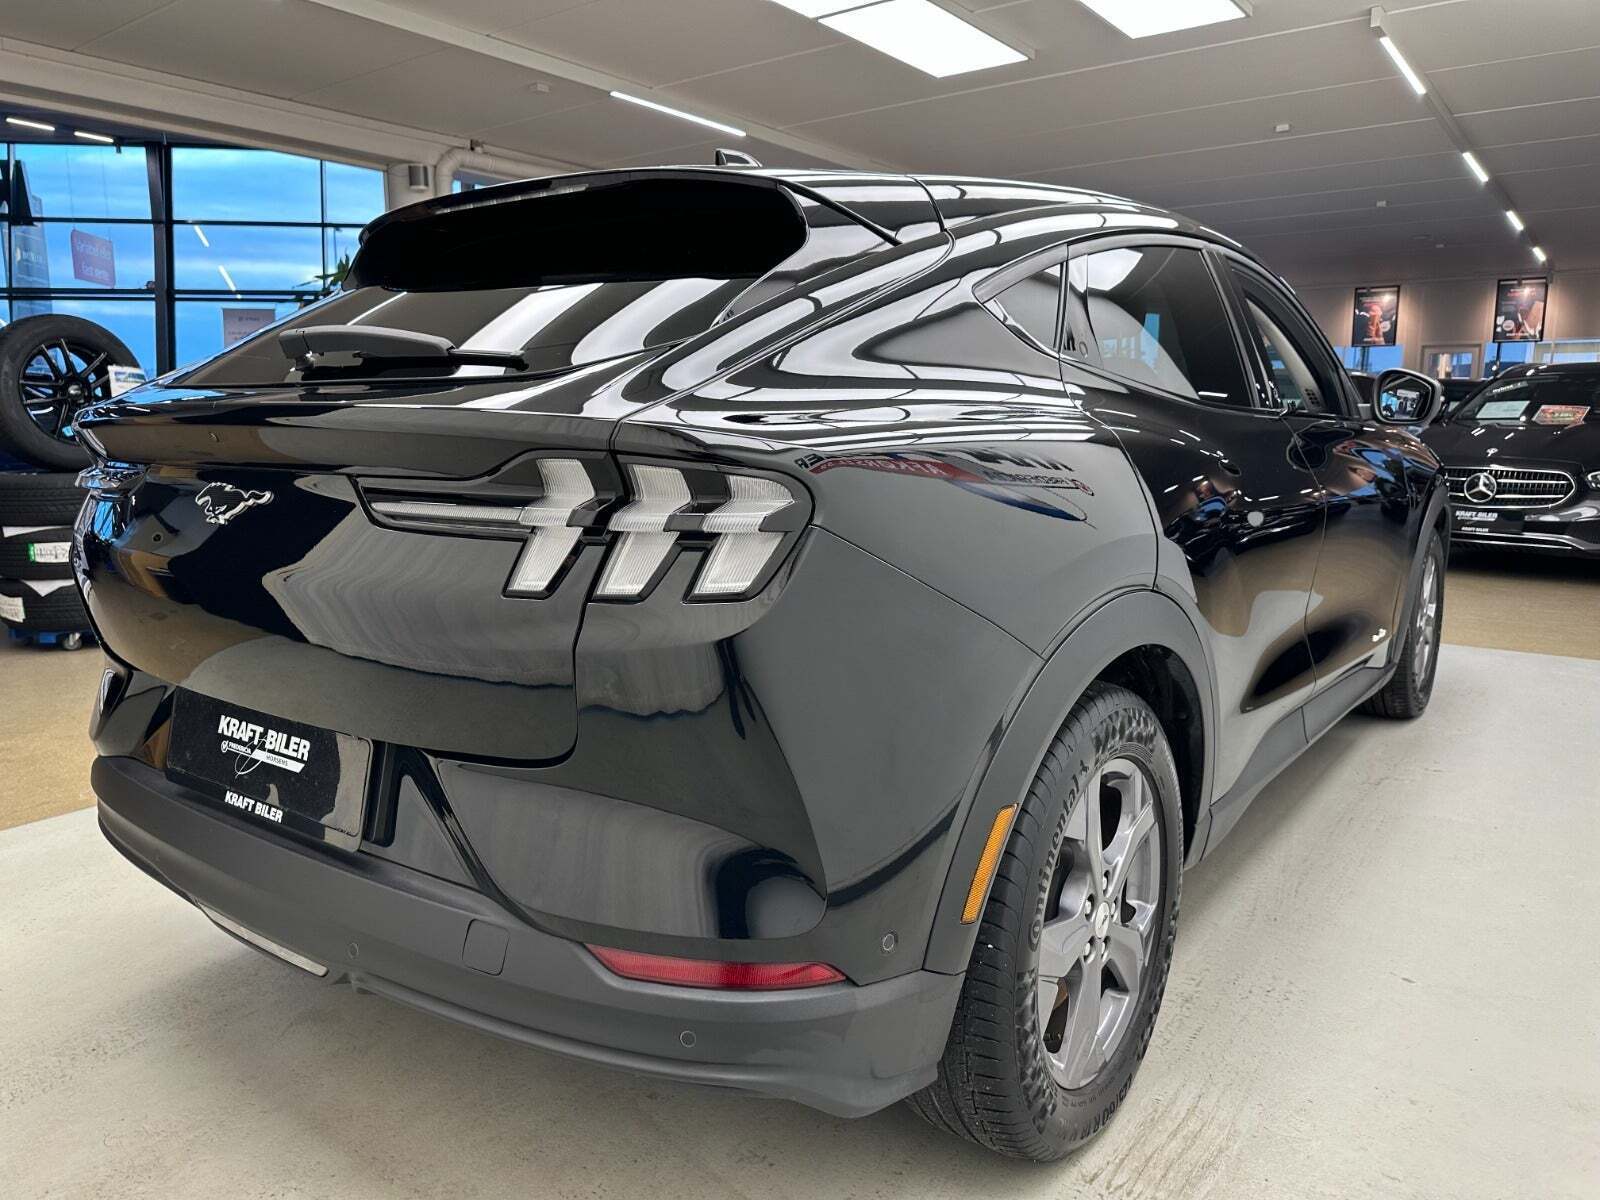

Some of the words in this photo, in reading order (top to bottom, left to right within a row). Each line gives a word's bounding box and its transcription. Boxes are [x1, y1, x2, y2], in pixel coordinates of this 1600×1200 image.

[217, 714, 264, 745] KRAFT
[264, 729, 311, 762] BILER
[224, 790, 256, 812] KRAFT
[254, 801, 284, 824] BILER
[1028, 773, 1081, 952] Continental
